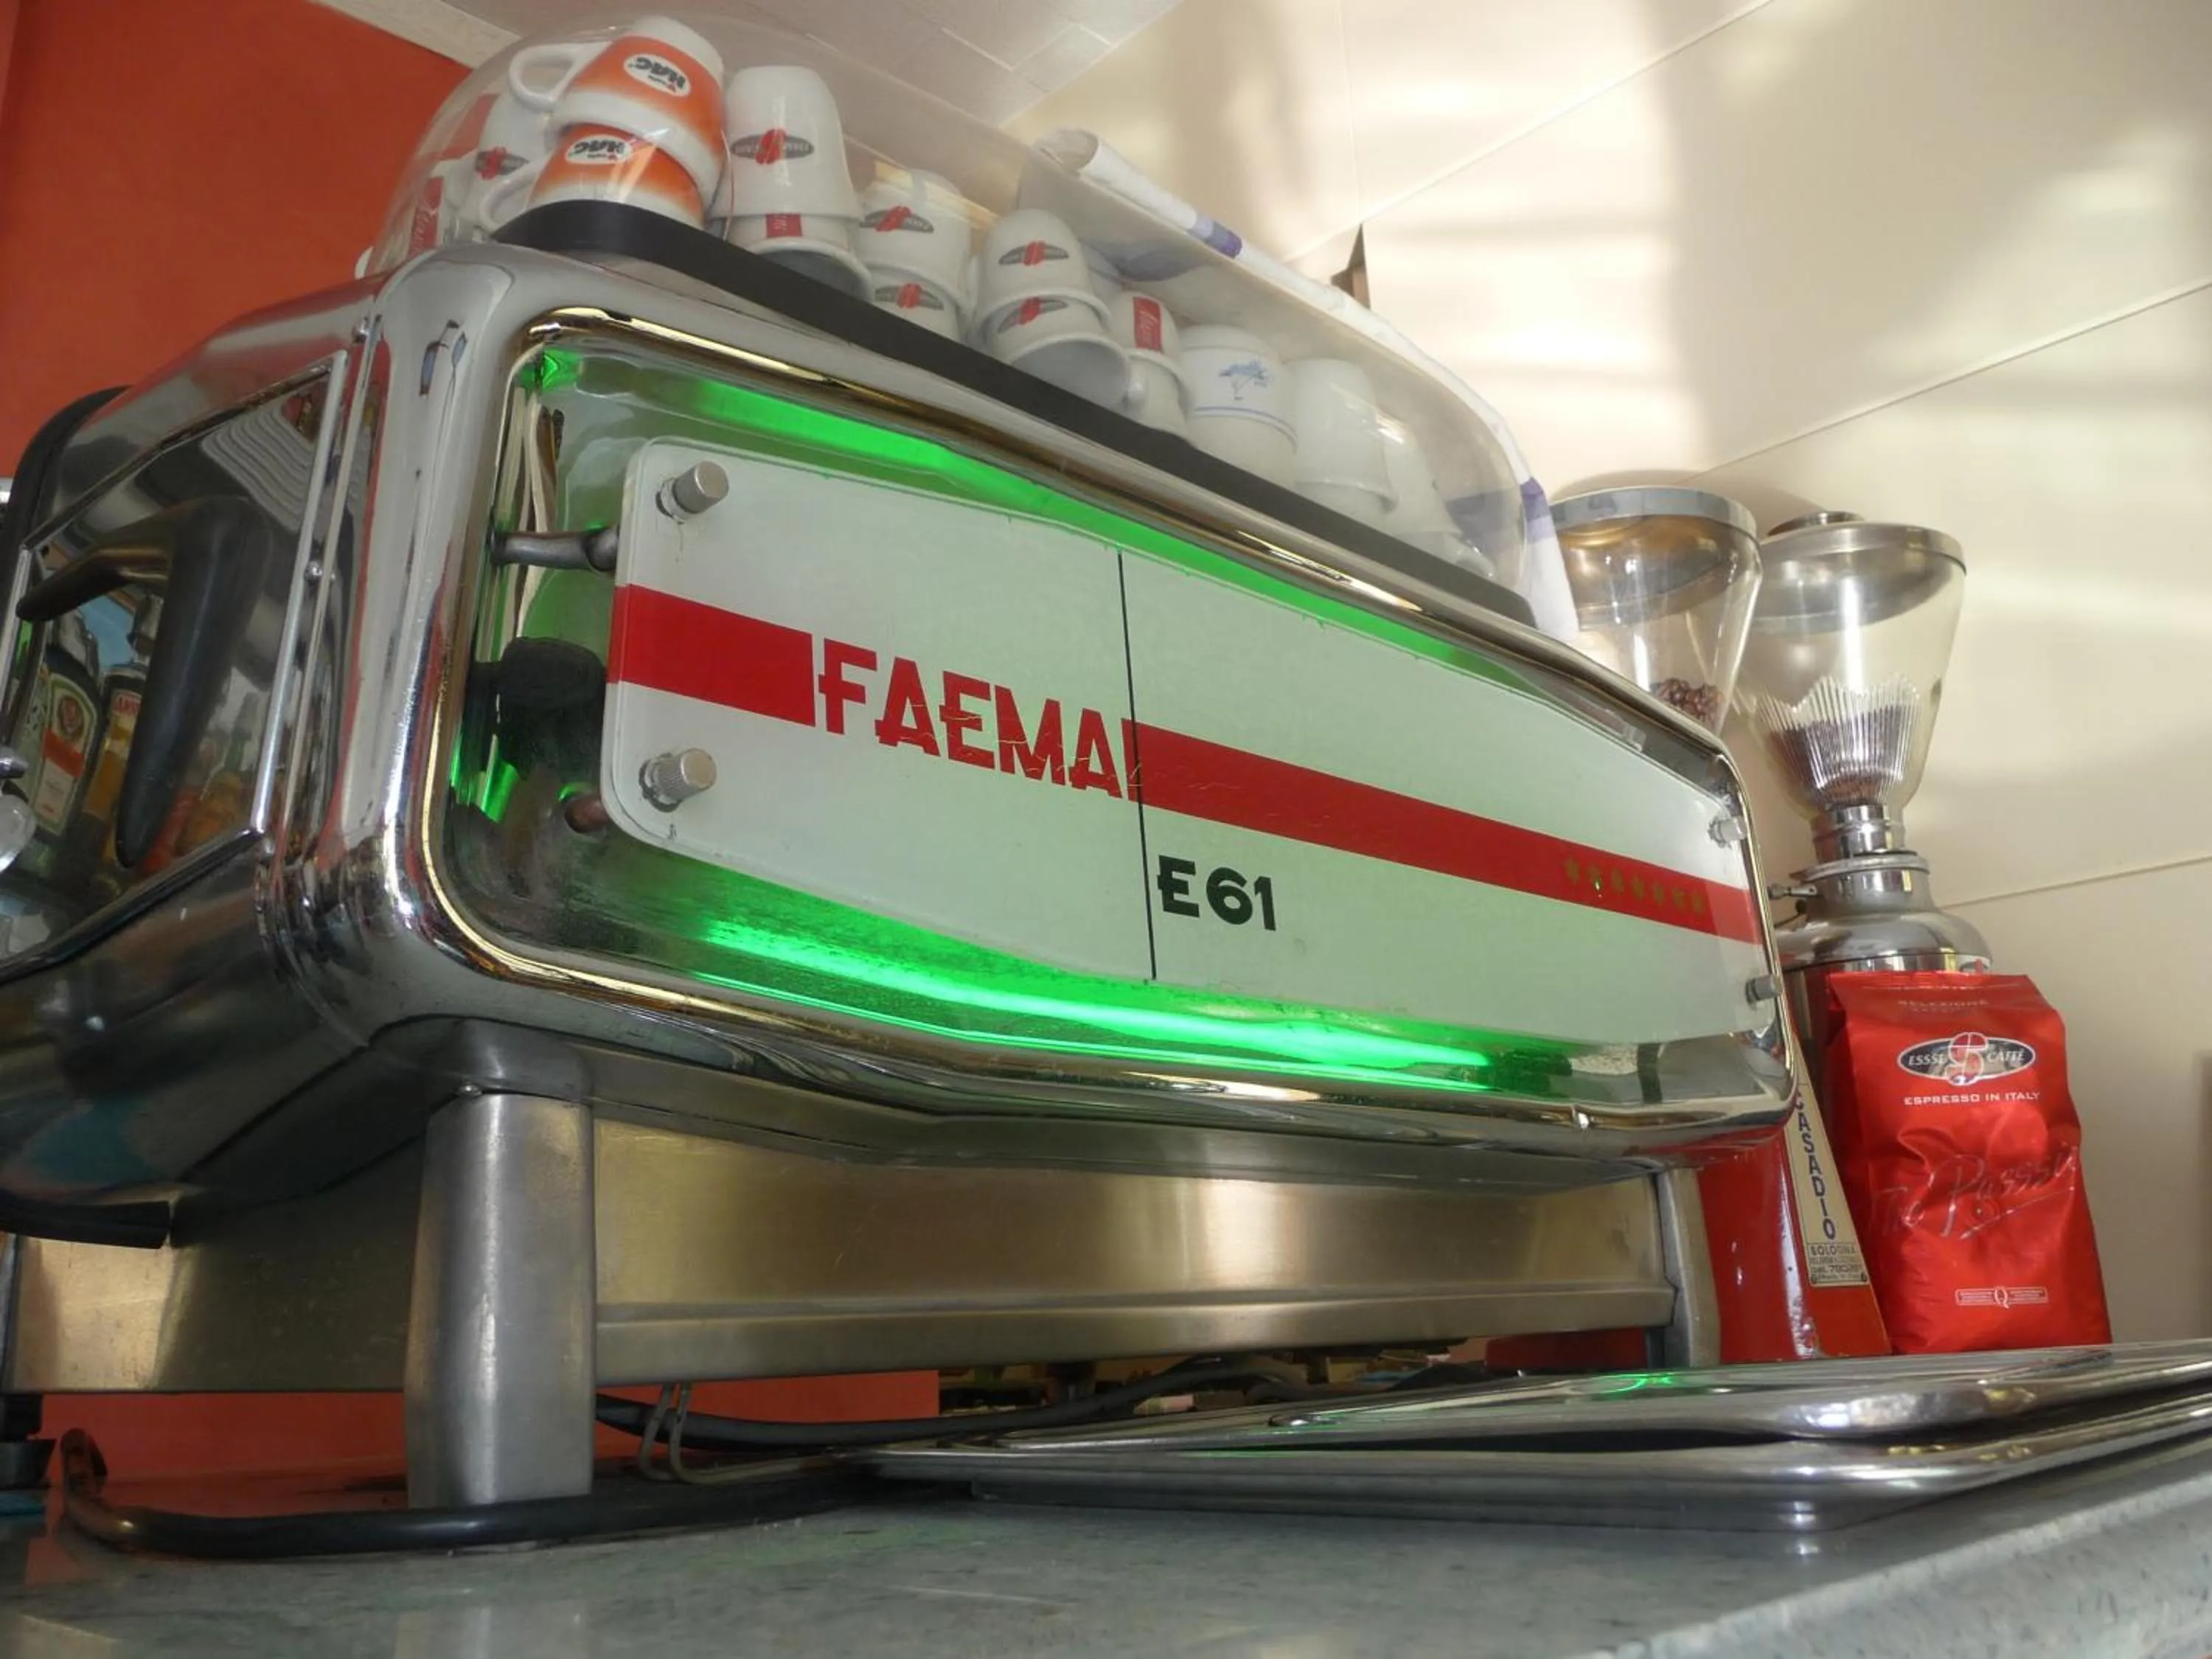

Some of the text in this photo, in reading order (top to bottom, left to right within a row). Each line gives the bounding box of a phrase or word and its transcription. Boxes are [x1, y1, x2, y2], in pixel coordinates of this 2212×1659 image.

[818, 637, 1123, 799] FAEMA
[1157, 855, 1276, 932] E61
[1903, 1091, 2040, 1106] ESPRESSO IN ITALY
